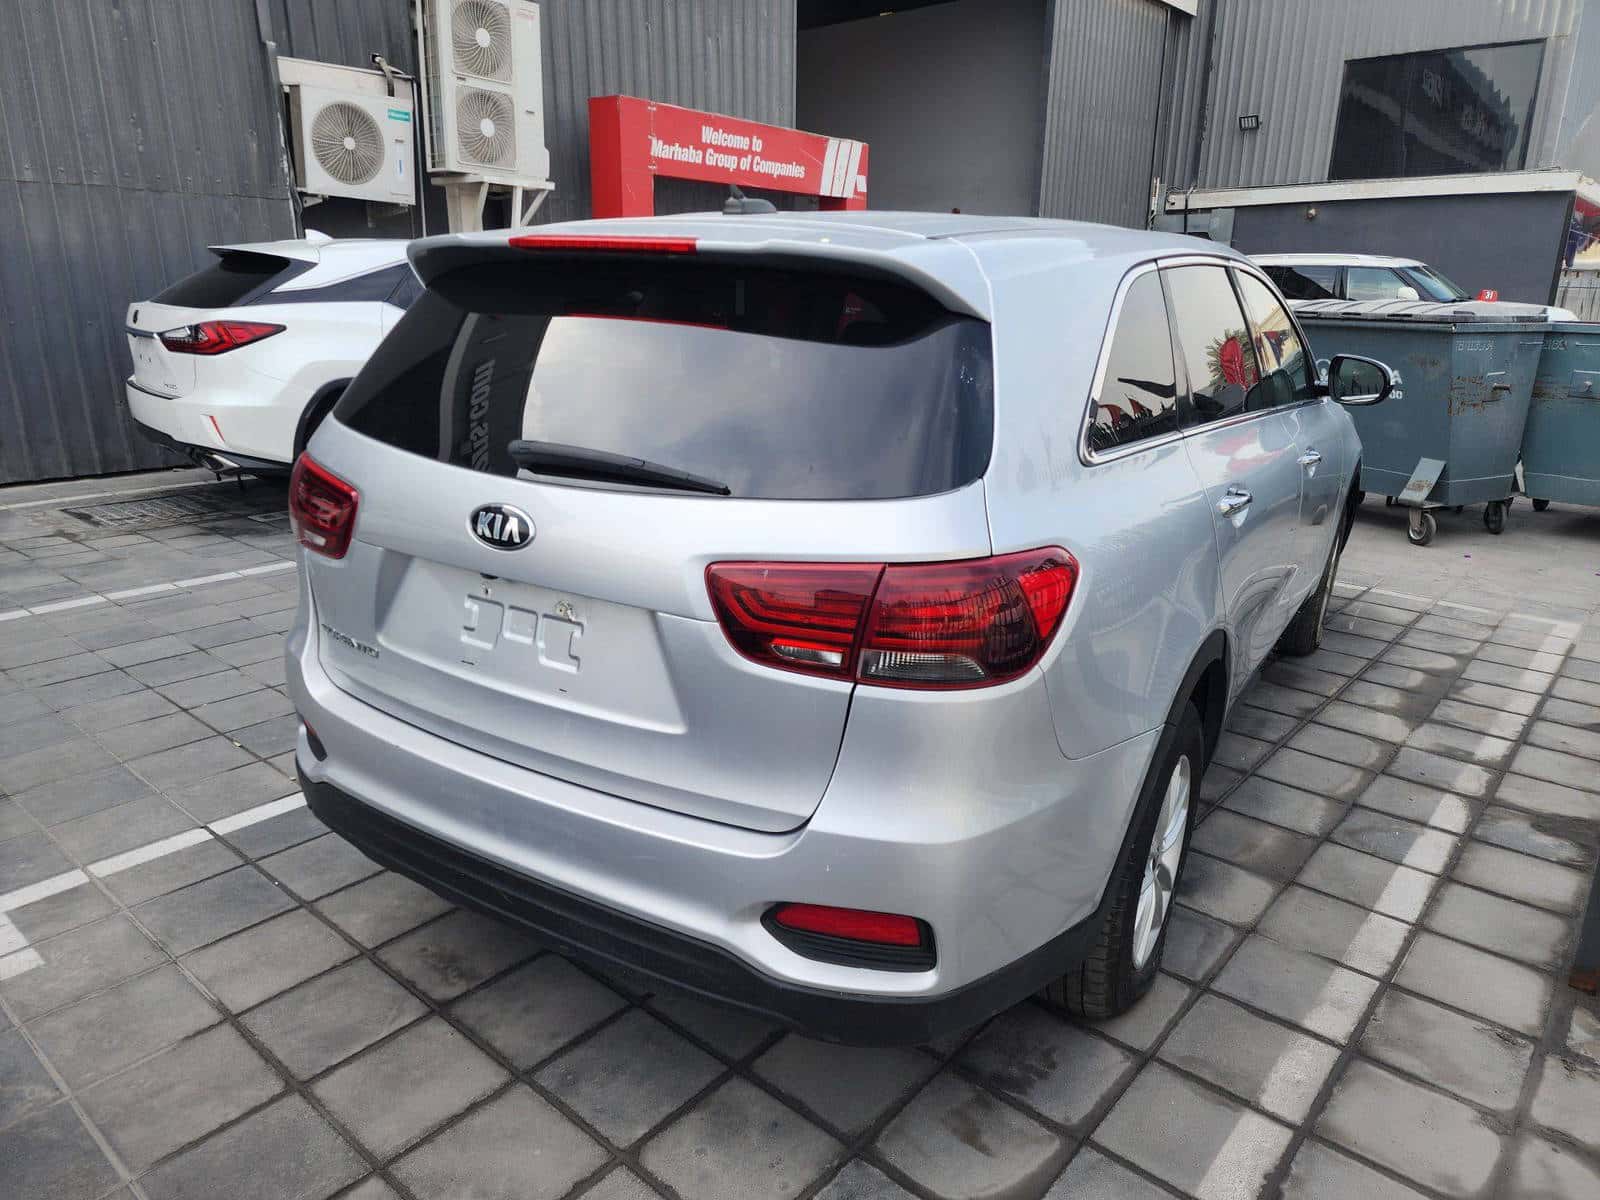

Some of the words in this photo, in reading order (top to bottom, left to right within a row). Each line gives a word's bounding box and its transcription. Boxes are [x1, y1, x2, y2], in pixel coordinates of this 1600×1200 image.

[701, 125, 750, 151] Welcome
[752, 135, 763, 152] to
[650, 138, 703, 164] Marhaba
[705, 148, 738, 172] Group
[740, 155, 751, 172] of
[753, 155, 806, 178] Companies
[477, 511, 521, 543] KIA
